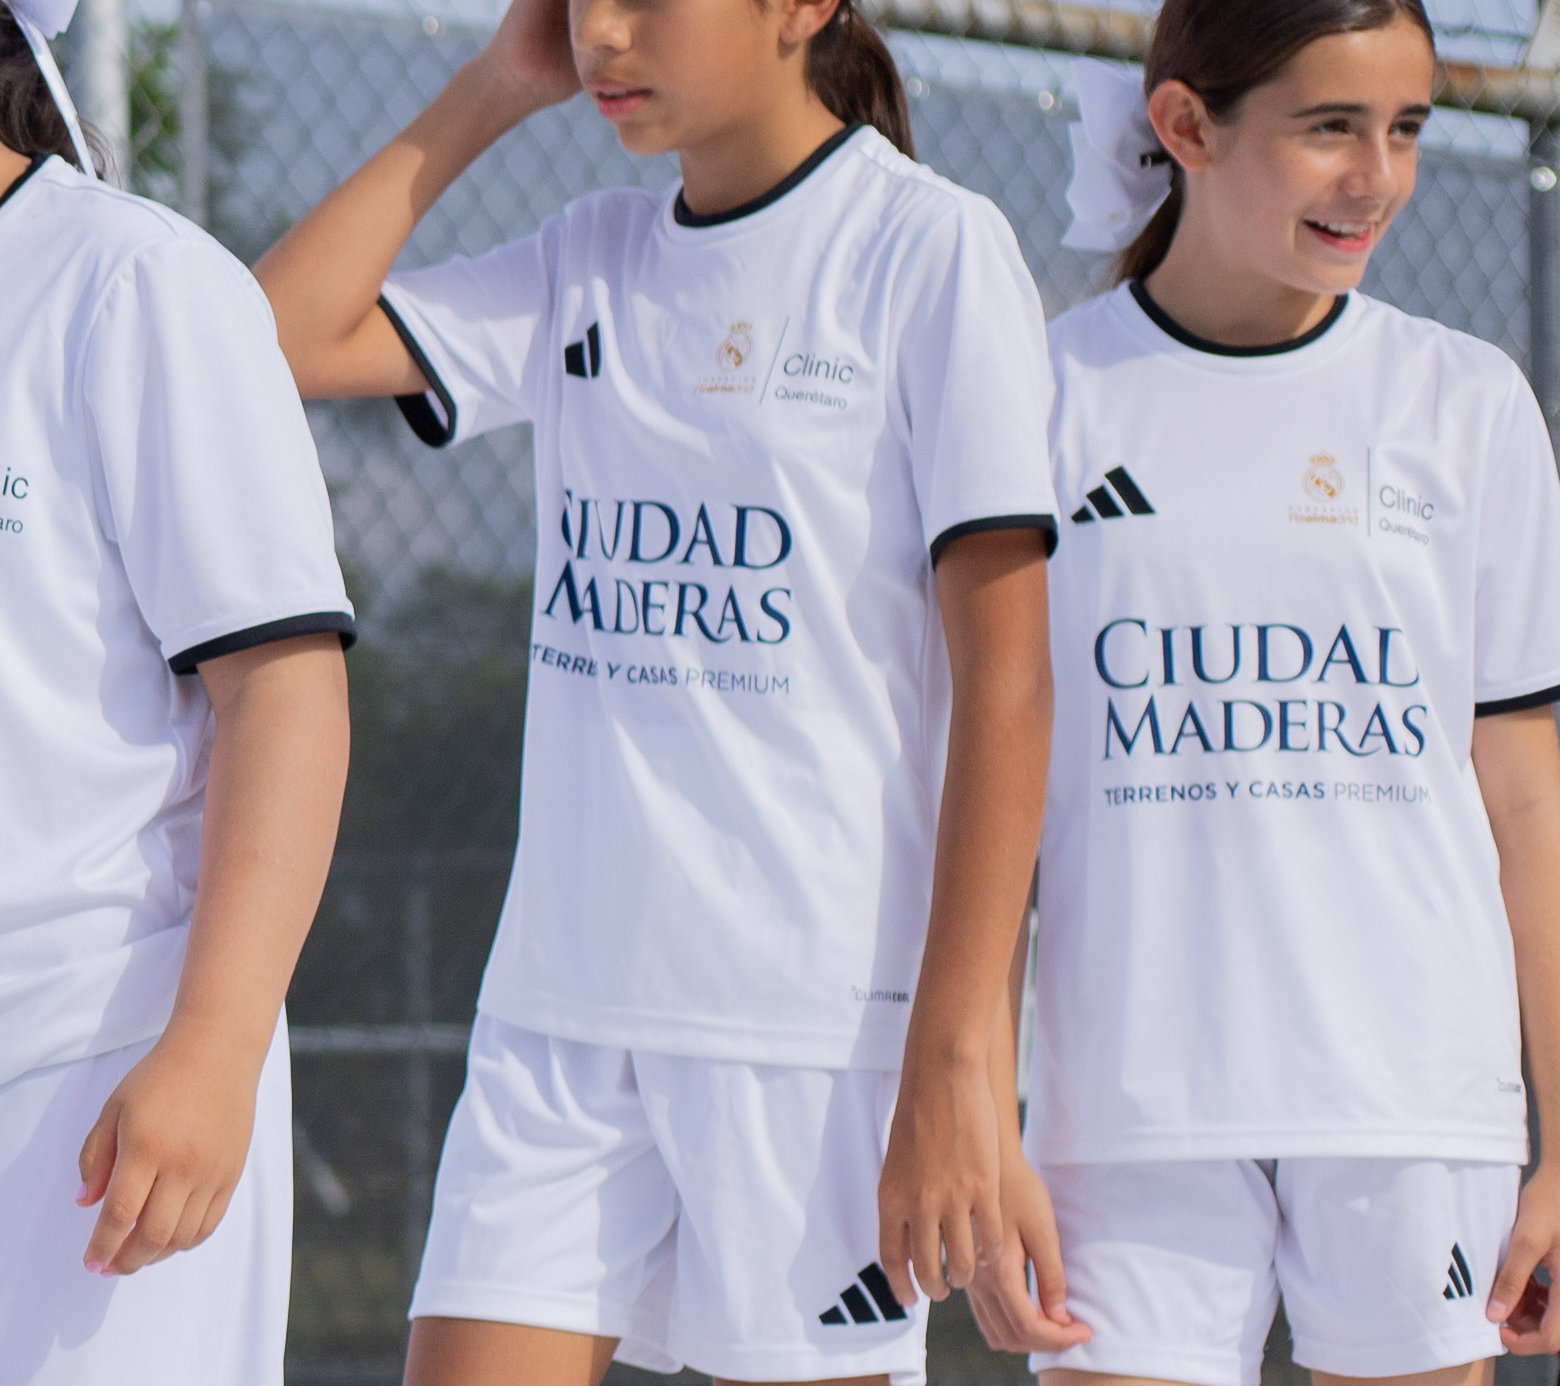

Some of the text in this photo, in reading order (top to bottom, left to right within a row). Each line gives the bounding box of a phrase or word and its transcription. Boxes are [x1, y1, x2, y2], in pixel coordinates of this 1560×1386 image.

[783, 353, 854, 384] Clinic
[1379, 485, 1435, 521] Clinic
[606, 663, 621, 680] Y
[627, 664, 678, 686] CASAS
[686, 668, 791, 695] PREMIUM
[1102, 695, 1428, 762] MADERAS
[1104, 781, 1431, 805] TERRENOS Y CASAS PREMIUM
